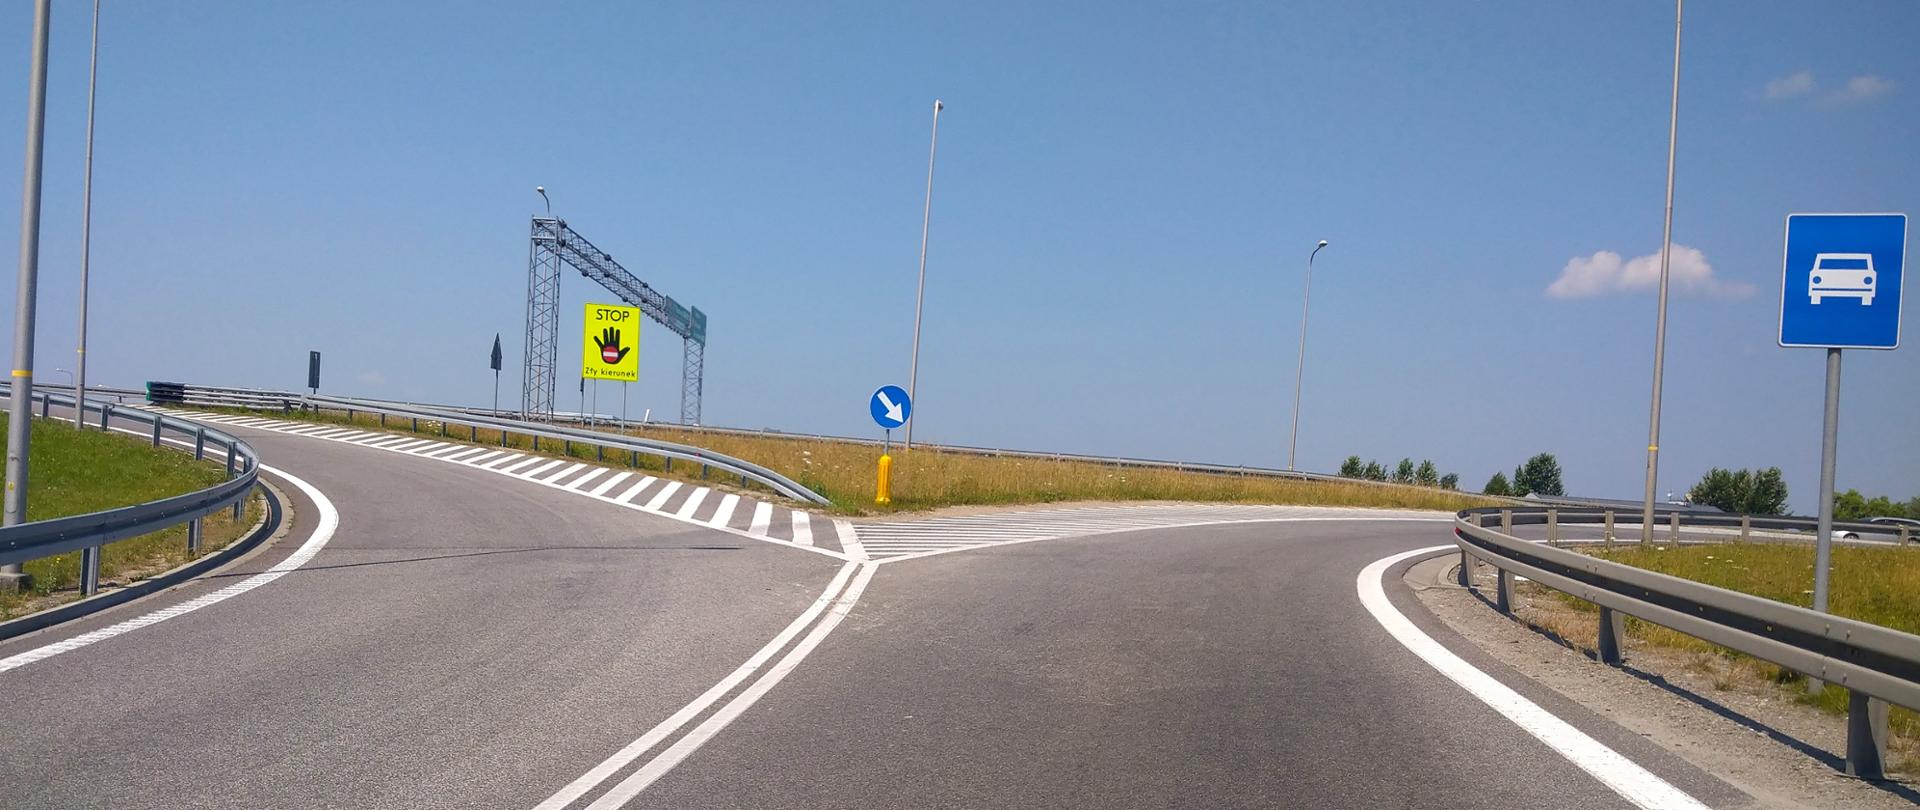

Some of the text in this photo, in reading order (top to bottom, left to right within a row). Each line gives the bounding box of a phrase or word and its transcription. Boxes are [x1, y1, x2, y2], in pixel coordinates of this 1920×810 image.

[595, 308, 630, 322] STOP
[585, 367, 636, 378] Zły kierunek
